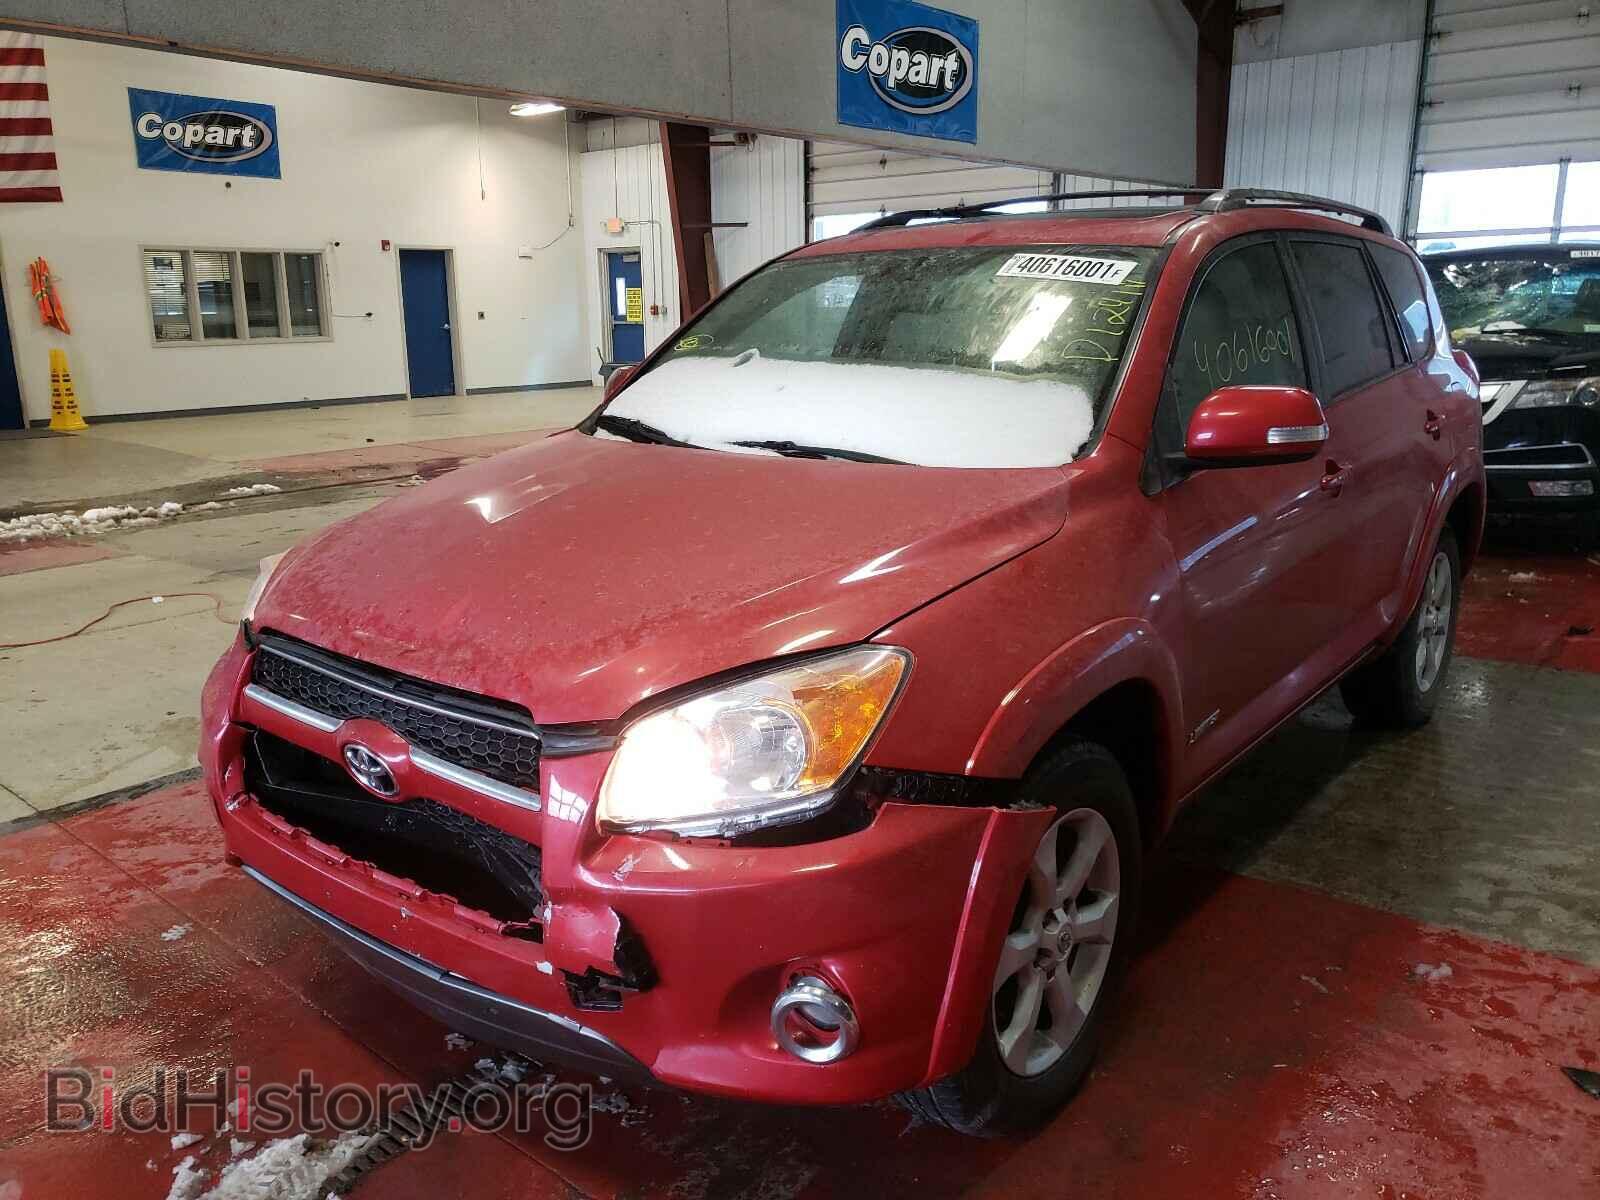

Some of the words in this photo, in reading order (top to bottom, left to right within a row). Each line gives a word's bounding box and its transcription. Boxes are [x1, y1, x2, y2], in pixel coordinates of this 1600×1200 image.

[840, 25, 960, 92] Copart
[137, 112, 257, 149] Copart
[1017, 256, 1114, 279] 40616001
